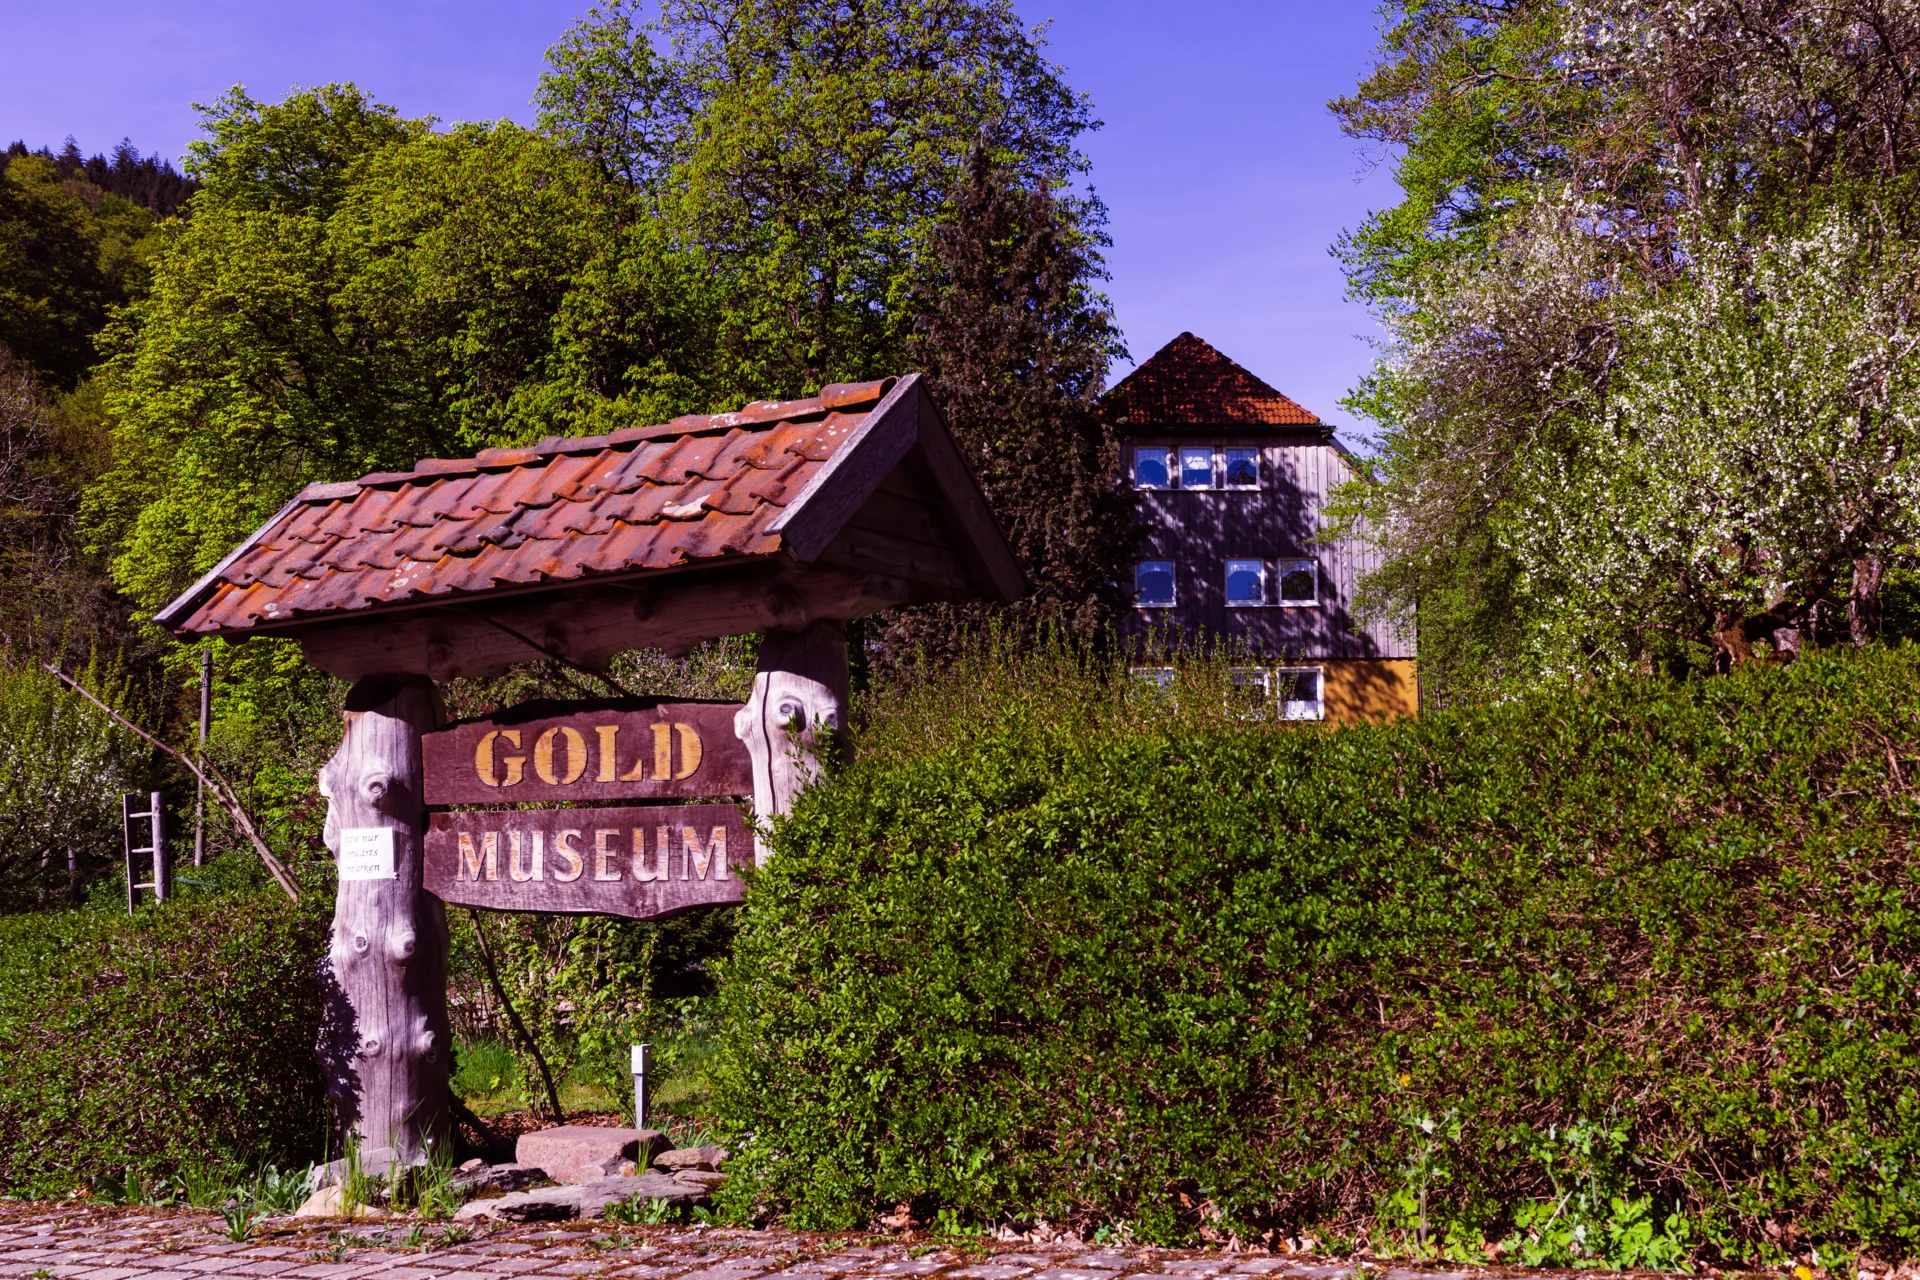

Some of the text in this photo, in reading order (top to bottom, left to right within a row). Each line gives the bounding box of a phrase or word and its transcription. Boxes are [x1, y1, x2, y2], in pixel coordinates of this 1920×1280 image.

[474, 722, 704, 788] GOLD
[362, 834, 380, 842] nur
[456, 825, 730, 883] MUSEUM
